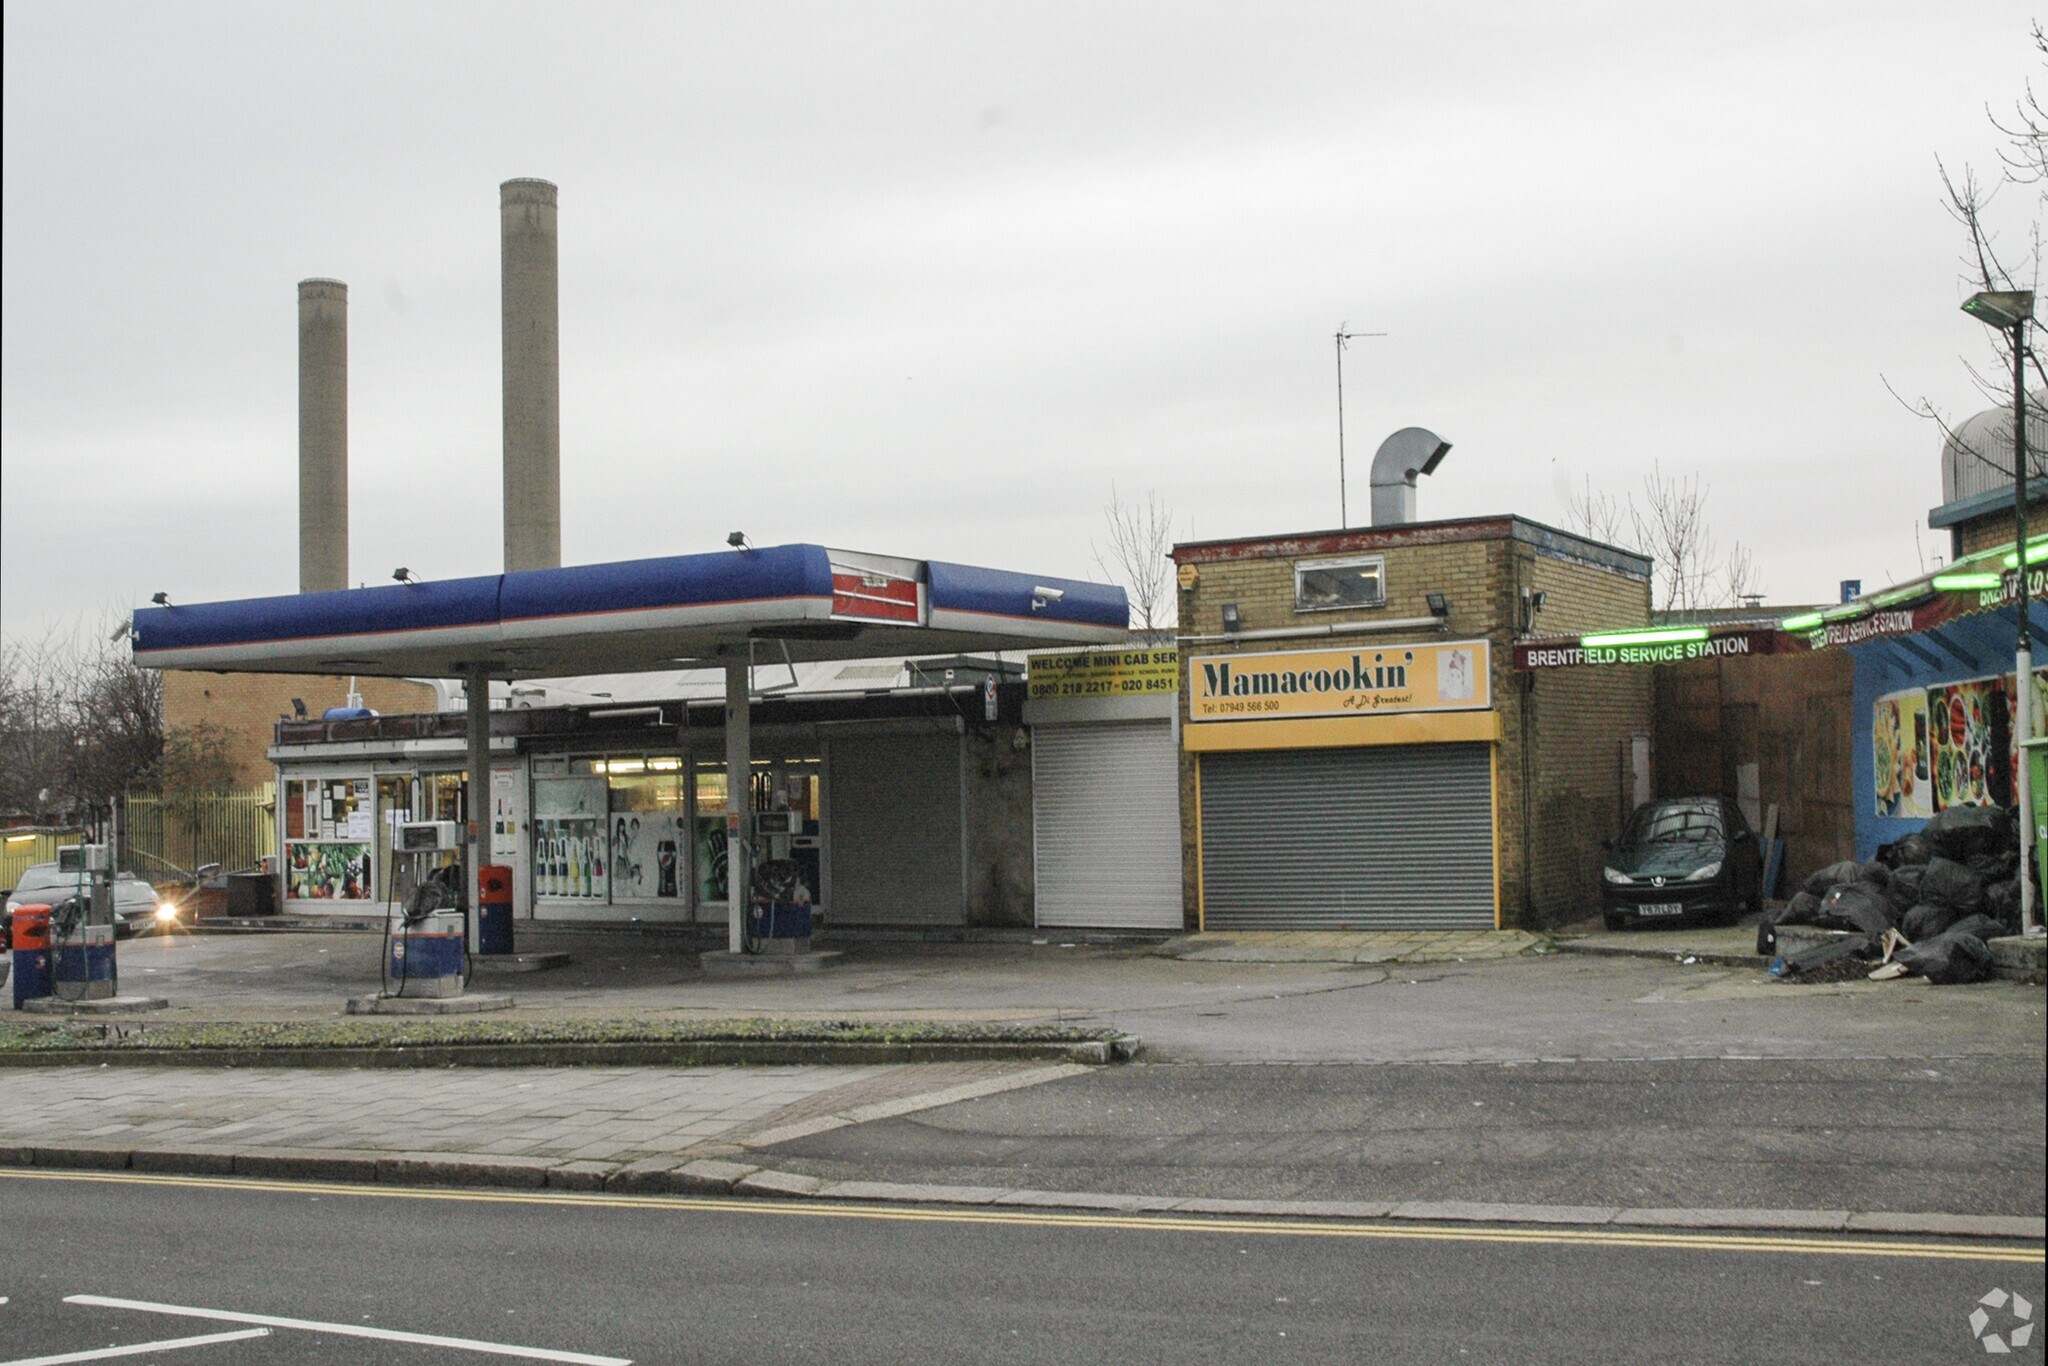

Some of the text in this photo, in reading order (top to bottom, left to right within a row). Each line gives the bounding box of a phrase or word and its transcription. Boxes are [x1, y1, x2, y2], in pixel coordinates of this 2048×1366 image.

[1880, 610, 1914, 634] STATION
[1031, 651, 1178, 670] WELCOME MINI CAB SER
[1527, 637, 1749, 666] BRENTFIELD SERVICE STATION
[1202, 651, 1414, 698] Mamacookin'
[1032, 683, 1059, 695] 0800
[1062, 682, 1082, 694] 218
[1085, 681, 1113, 693] 2217
[1122, 679, 1143, 691] 020
[1146, 678, 1174, 690] 8451
[1202, 700, 1280, 714] Tel: 07949 566 500
